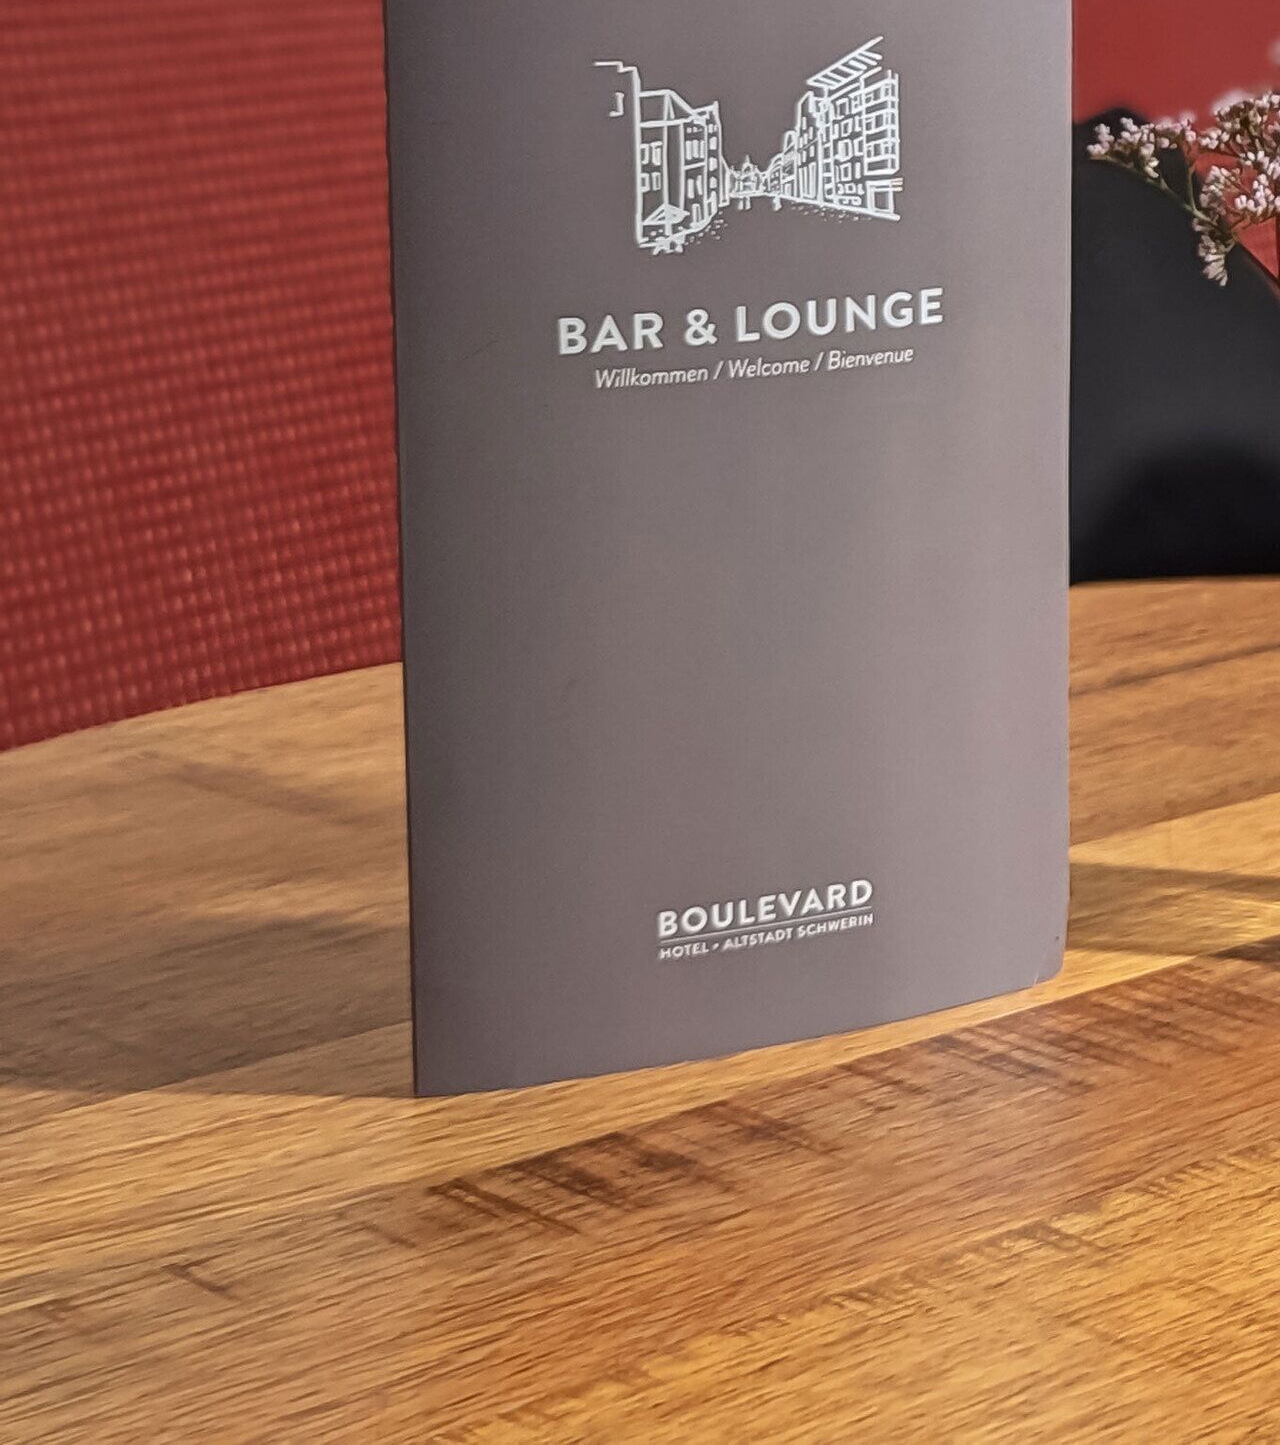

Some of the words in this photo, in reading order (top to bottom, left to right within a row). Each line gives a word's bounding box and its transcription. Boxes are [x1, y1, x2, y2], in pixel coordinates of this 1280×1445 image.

[557, 310, 664, 356] BAR
[684, 308, 719, 347] &
[735, 287, 944, 343] LOUNGE
[595, 365, 709, 389] Willkommen
[713, 360, 723, 381] /
[728, 355, 811, 380] Welcome
[814, 351, 825, 372] /
[827, 347, 914, 372] Bienvenue
[658, 879, 874, 938] BOULEVARD
[659, 941, 709, 960] HOTEL
[722, 927, 793, 951] ALTSTADT
[797, 913, 874, 938] SCHWERIN
